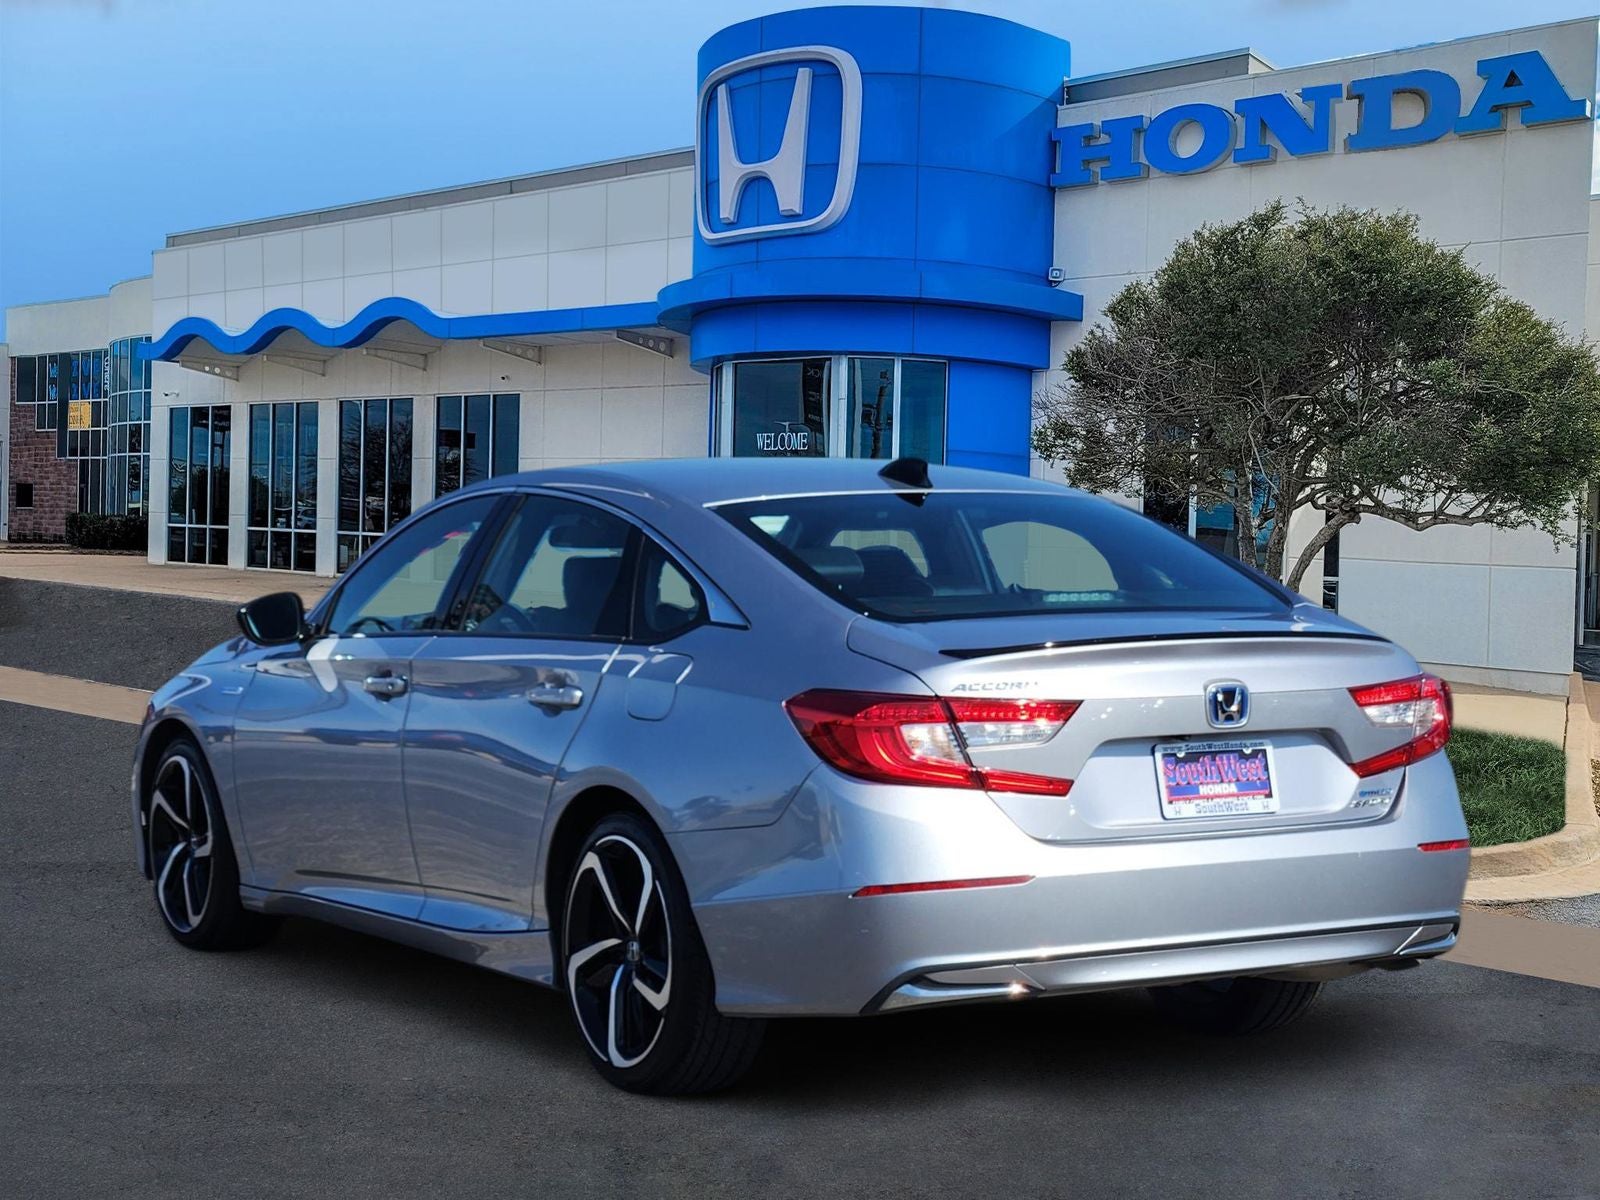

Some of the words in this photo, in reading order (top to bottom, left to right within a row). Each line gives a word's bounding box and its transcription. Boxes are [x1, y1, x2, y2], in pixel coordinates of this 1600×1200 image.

[1050, 50, 1590, 188] HONDA
[756, 432, 808, 450] WELCOME
[1163, 753, 1269, 785] SouthWest
[1199, 784, 1237, 795] HONDA
[1195, 801, 1249, 814] SouthWest
